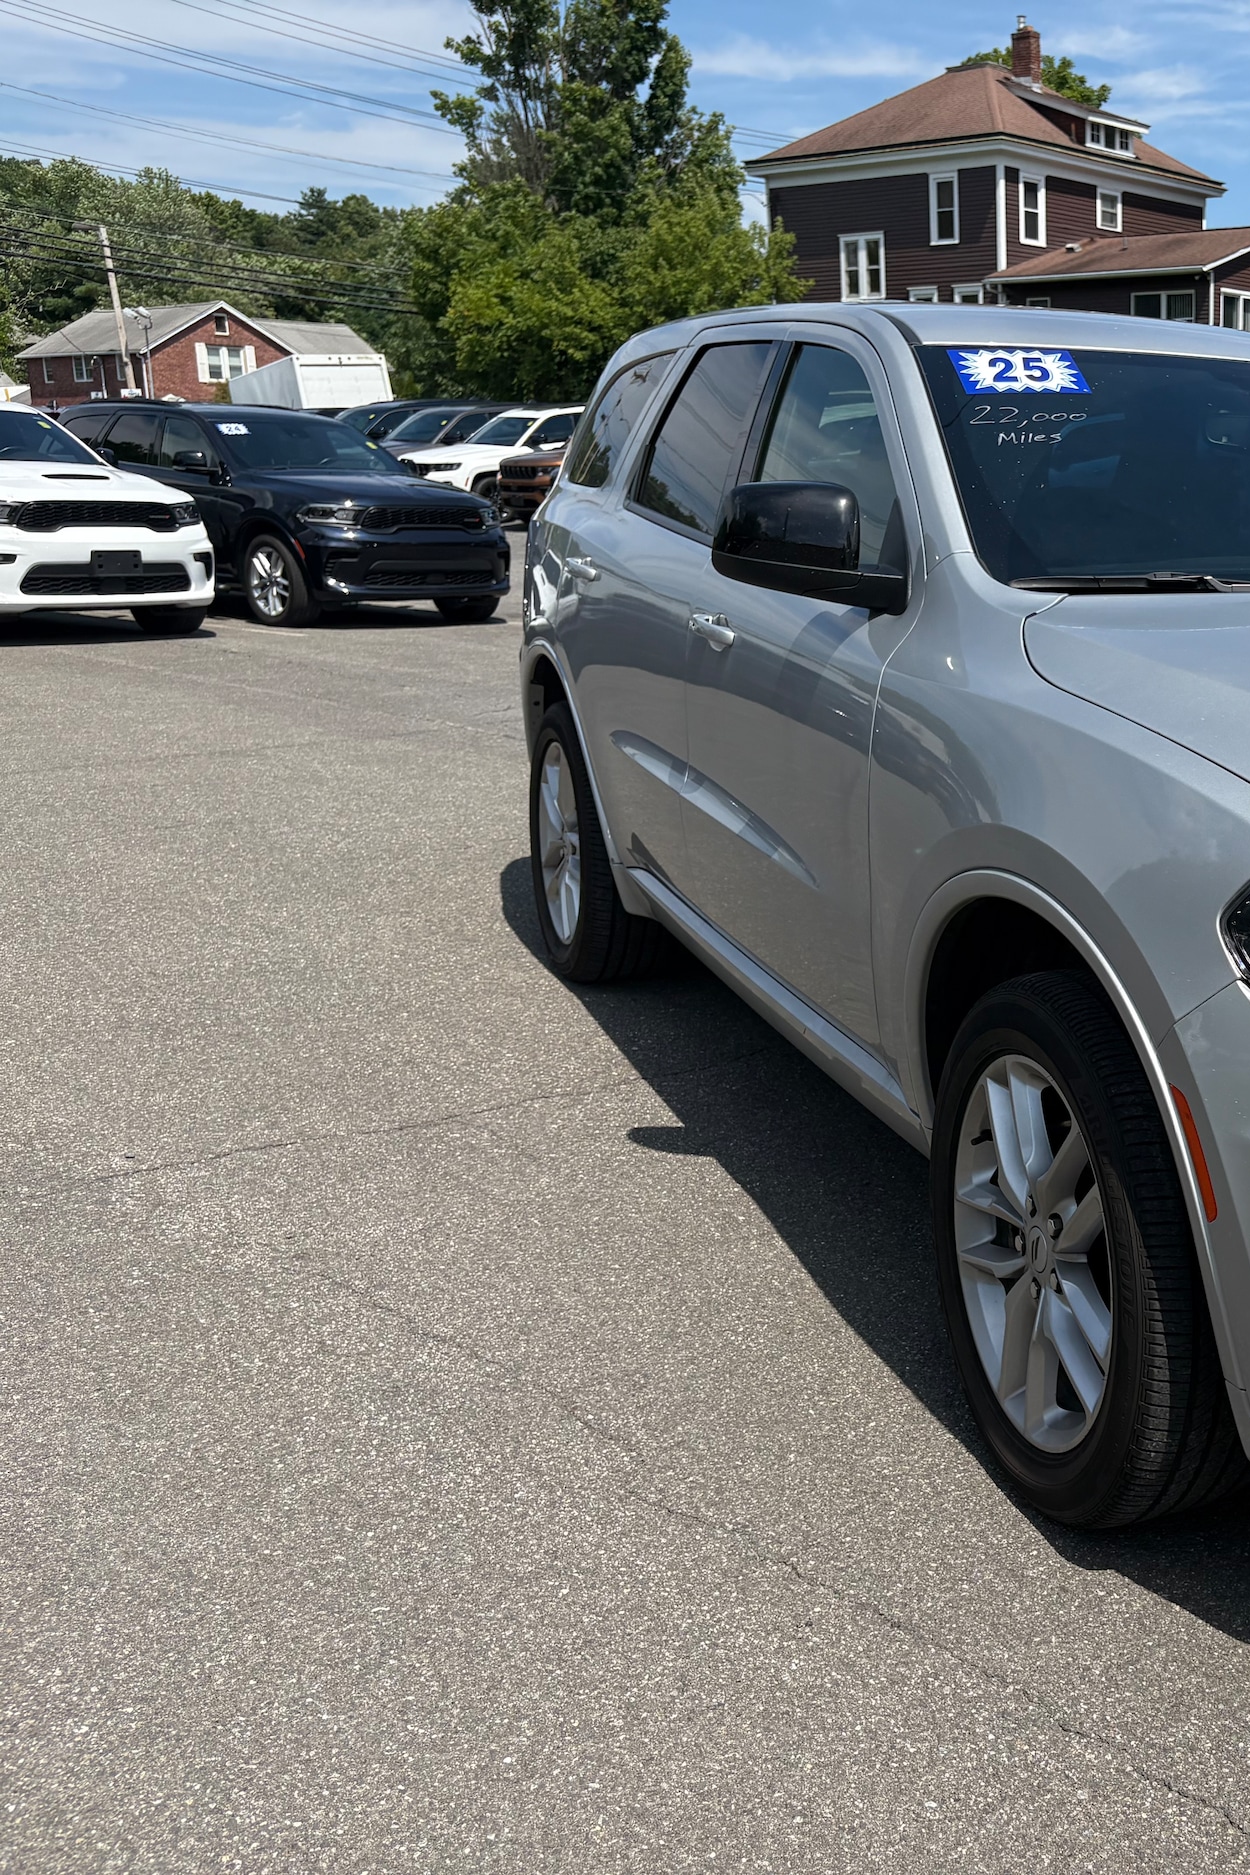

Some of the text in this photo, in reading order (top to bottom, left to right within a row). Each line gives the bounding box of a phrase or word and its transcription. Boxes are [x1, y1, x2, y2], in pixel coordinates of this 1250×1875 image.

[987, 357, 1051, 383] 25
[969, 405, 1087, 429] 22,000
[997, 431, 1063, 446] Miles
